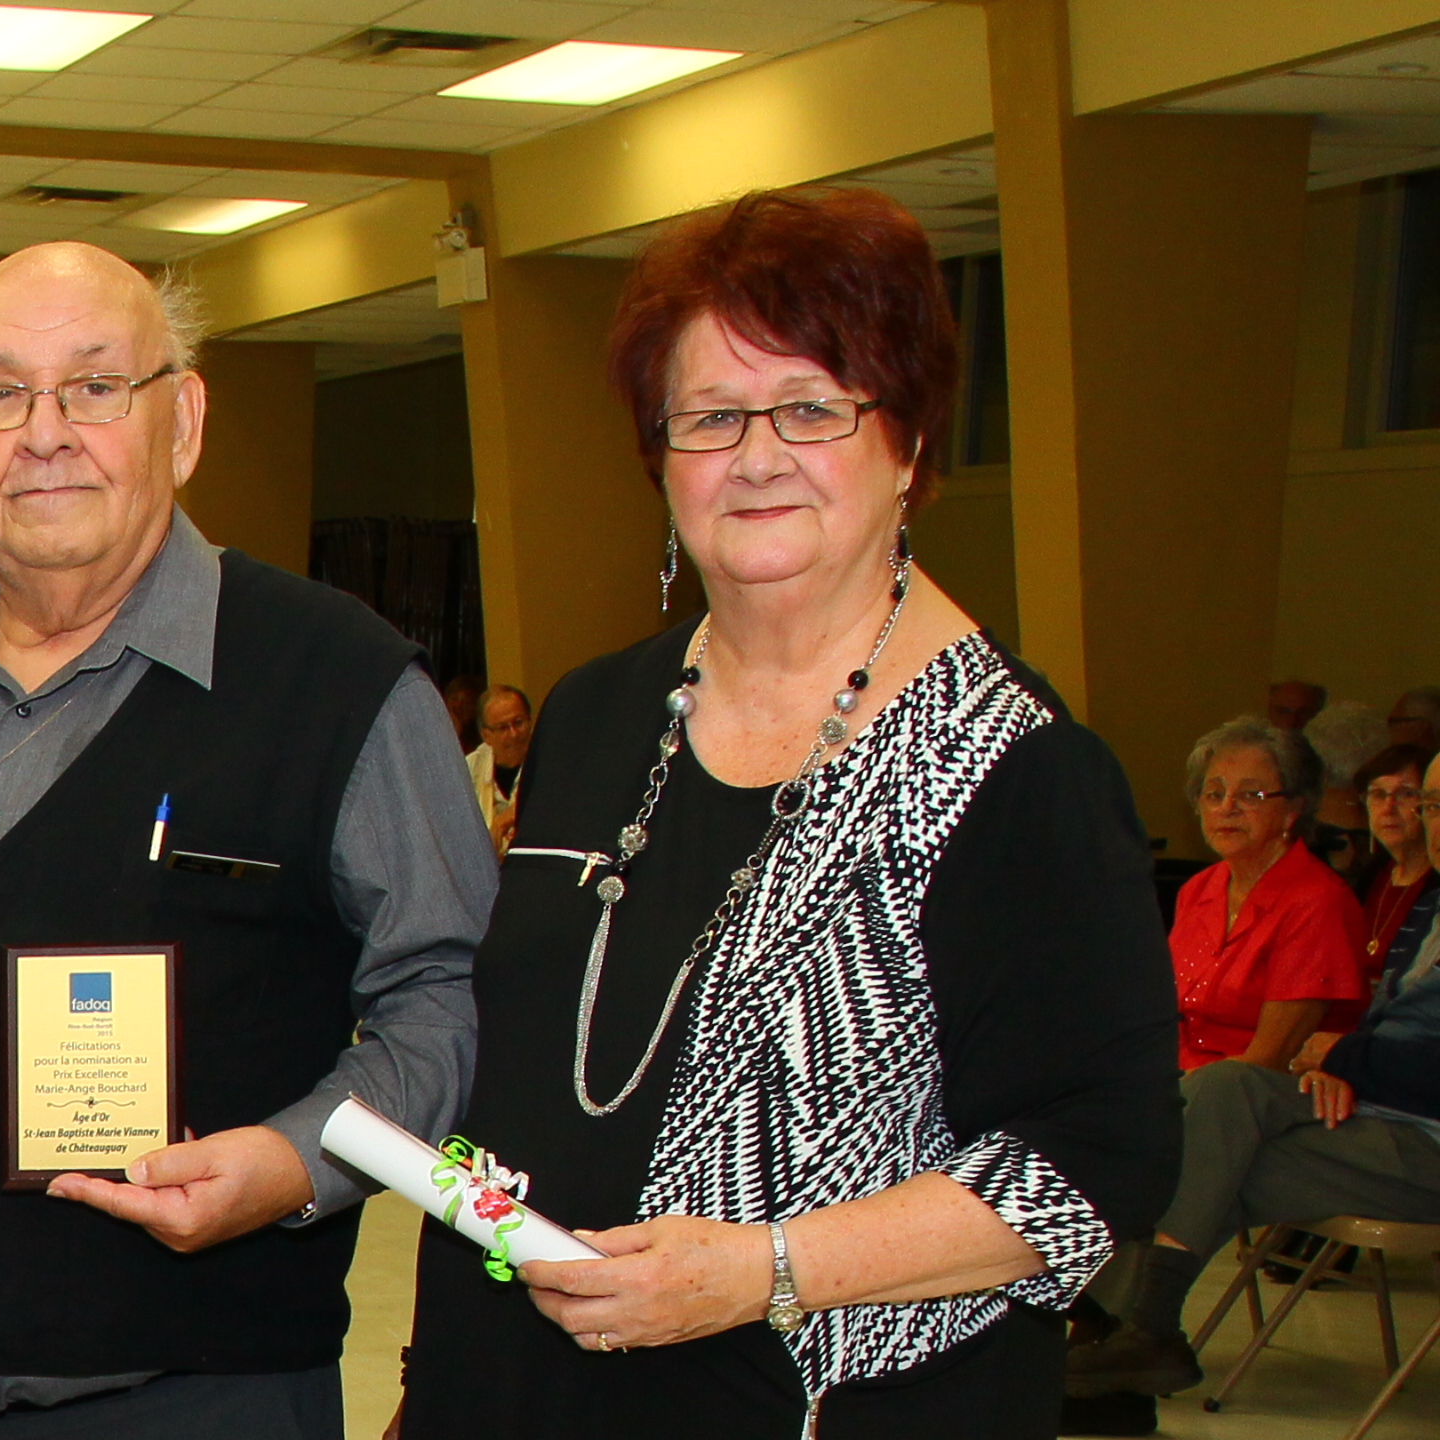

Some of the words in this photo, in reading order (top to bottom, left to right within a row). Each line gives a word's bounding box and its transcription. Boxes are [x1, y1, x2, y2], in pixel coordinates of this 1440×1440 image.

[71, 997, 111, 1012] fadoq
[60, 1041, 121, 1051] Félicitations
[33, 1058, 58, 1067] pour
[60, 1055, 70, 1065] la
[72, 1055, 132, 1065] nomination
[134, 1056, 148, 1064] au
[53, 1069, 73, 1079] Prix
[75, 1069, 129, 1079] Excellence
[34, 1084, 96, 1095] Marie-Ange
[97, 1082, 147, 1093] Bouchard
[72, 1111, 90, 1124] Âge
[91, 1112, 110, 1122] d'Or
[23, 1128, 56, 1139] St-Jean
[57, 1128, 95, 1139] Baptiste
[95, 1127, 122, 1137] Marie
[123, 1126, 160, 1138] Vianney
[55, 1143, 67, 1153] de
[68, 1142, 128, 1155] Châteauguay
